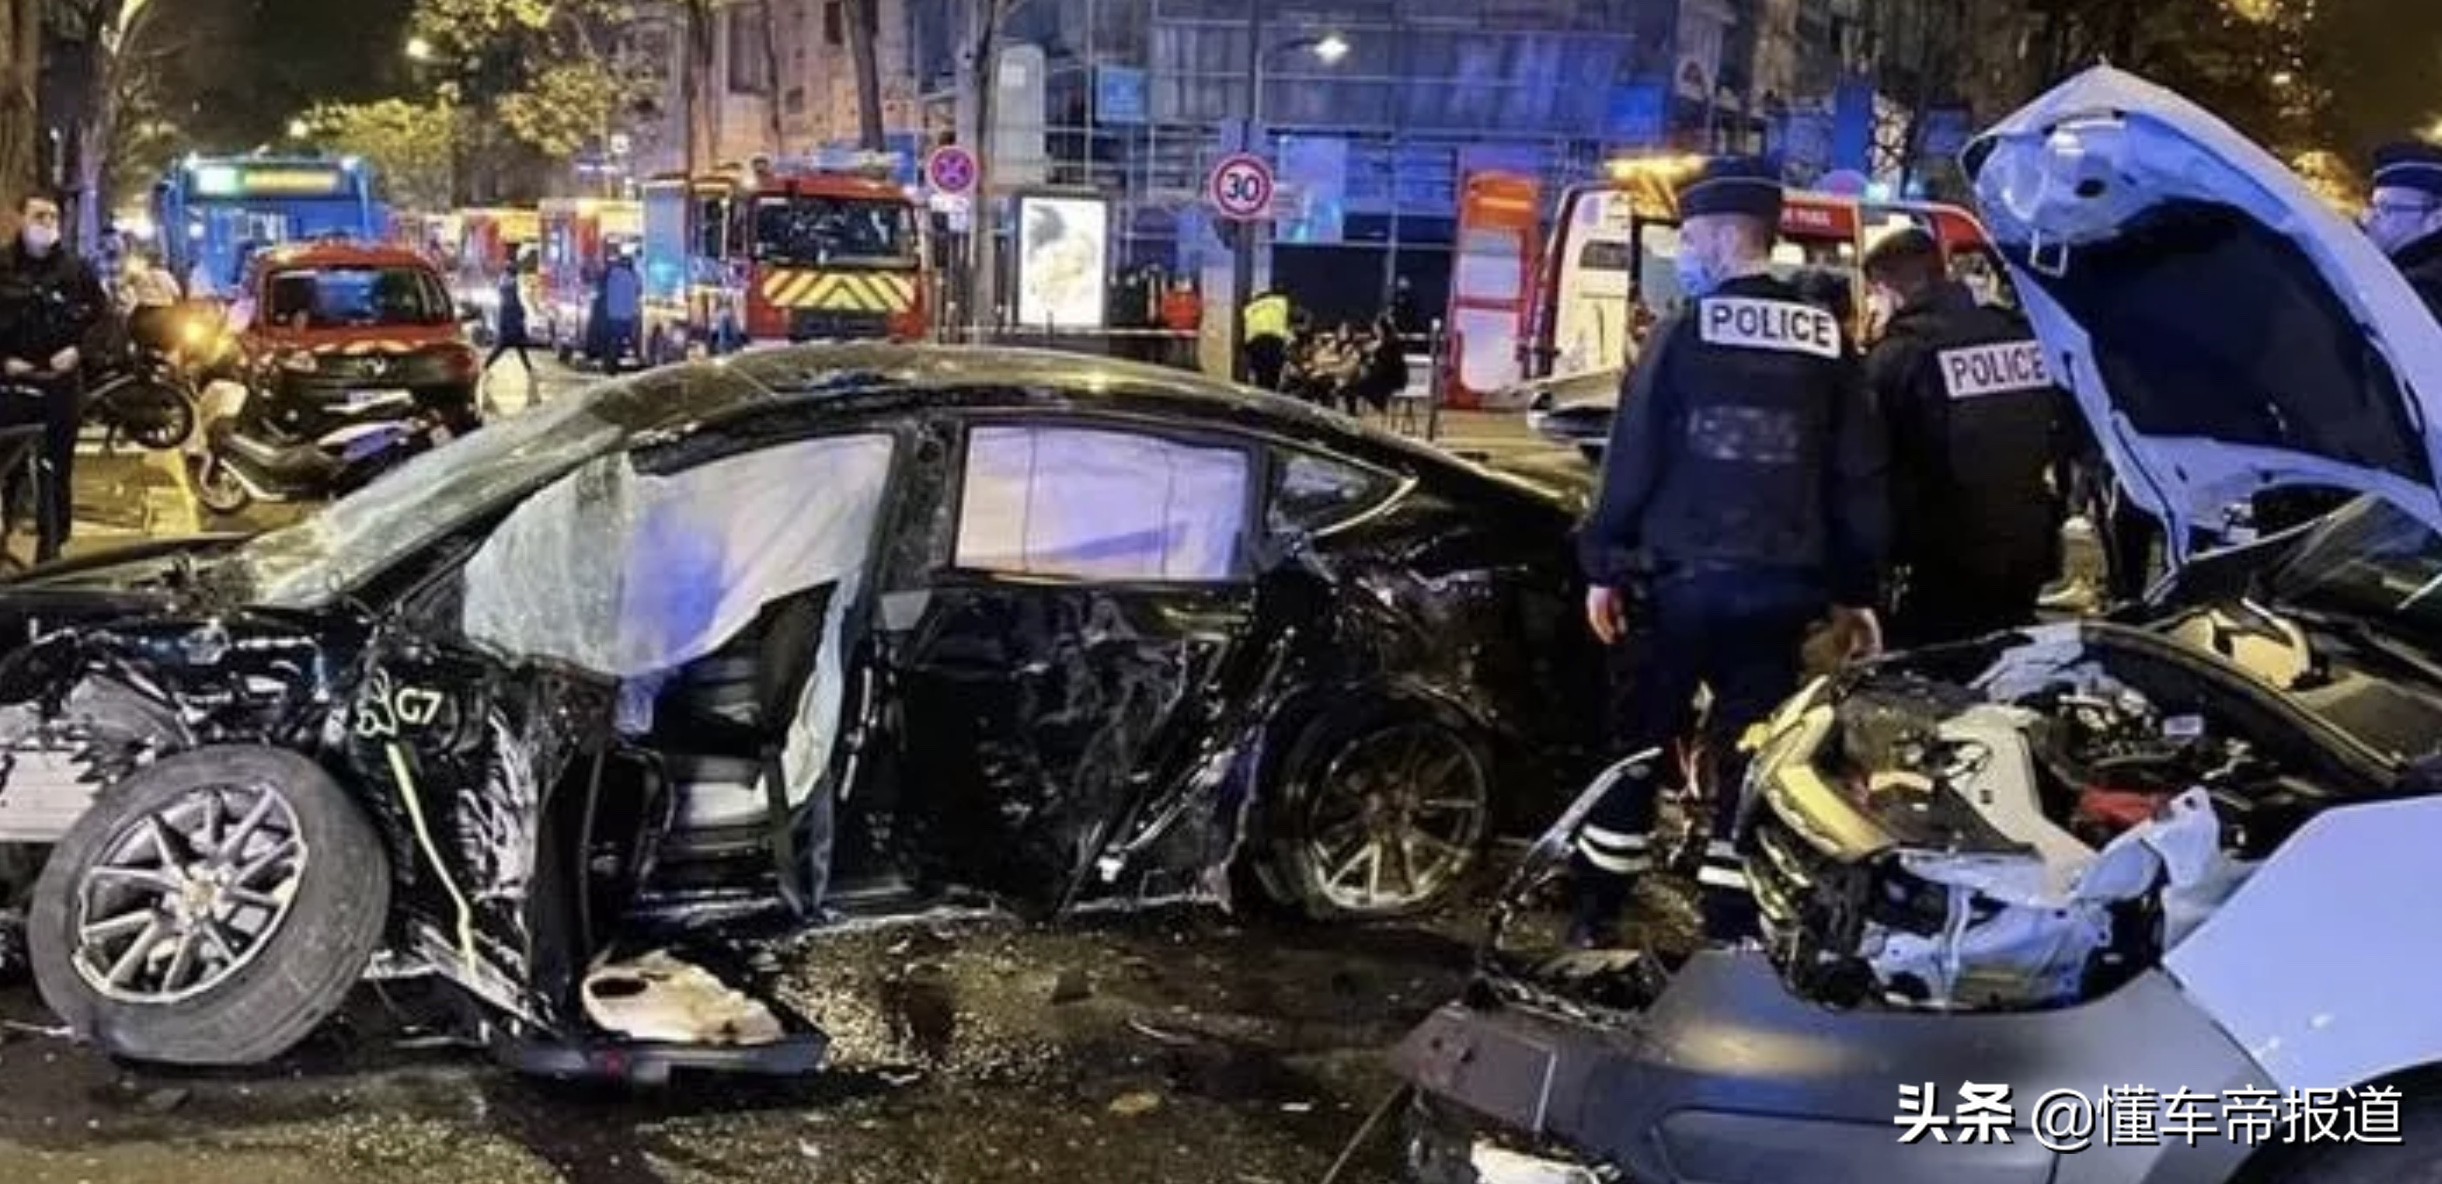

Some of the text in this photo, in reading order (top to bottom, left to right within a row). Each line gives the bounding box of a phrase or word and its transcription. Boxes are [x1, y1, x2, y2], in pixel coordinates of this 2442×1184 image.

[1225, 172, 1259, 201] 30
[1711, 304, 1831, 347] POLICE
[1950, 347, 2045, 390] POLICE
[396, 687, 442, 724] G7
